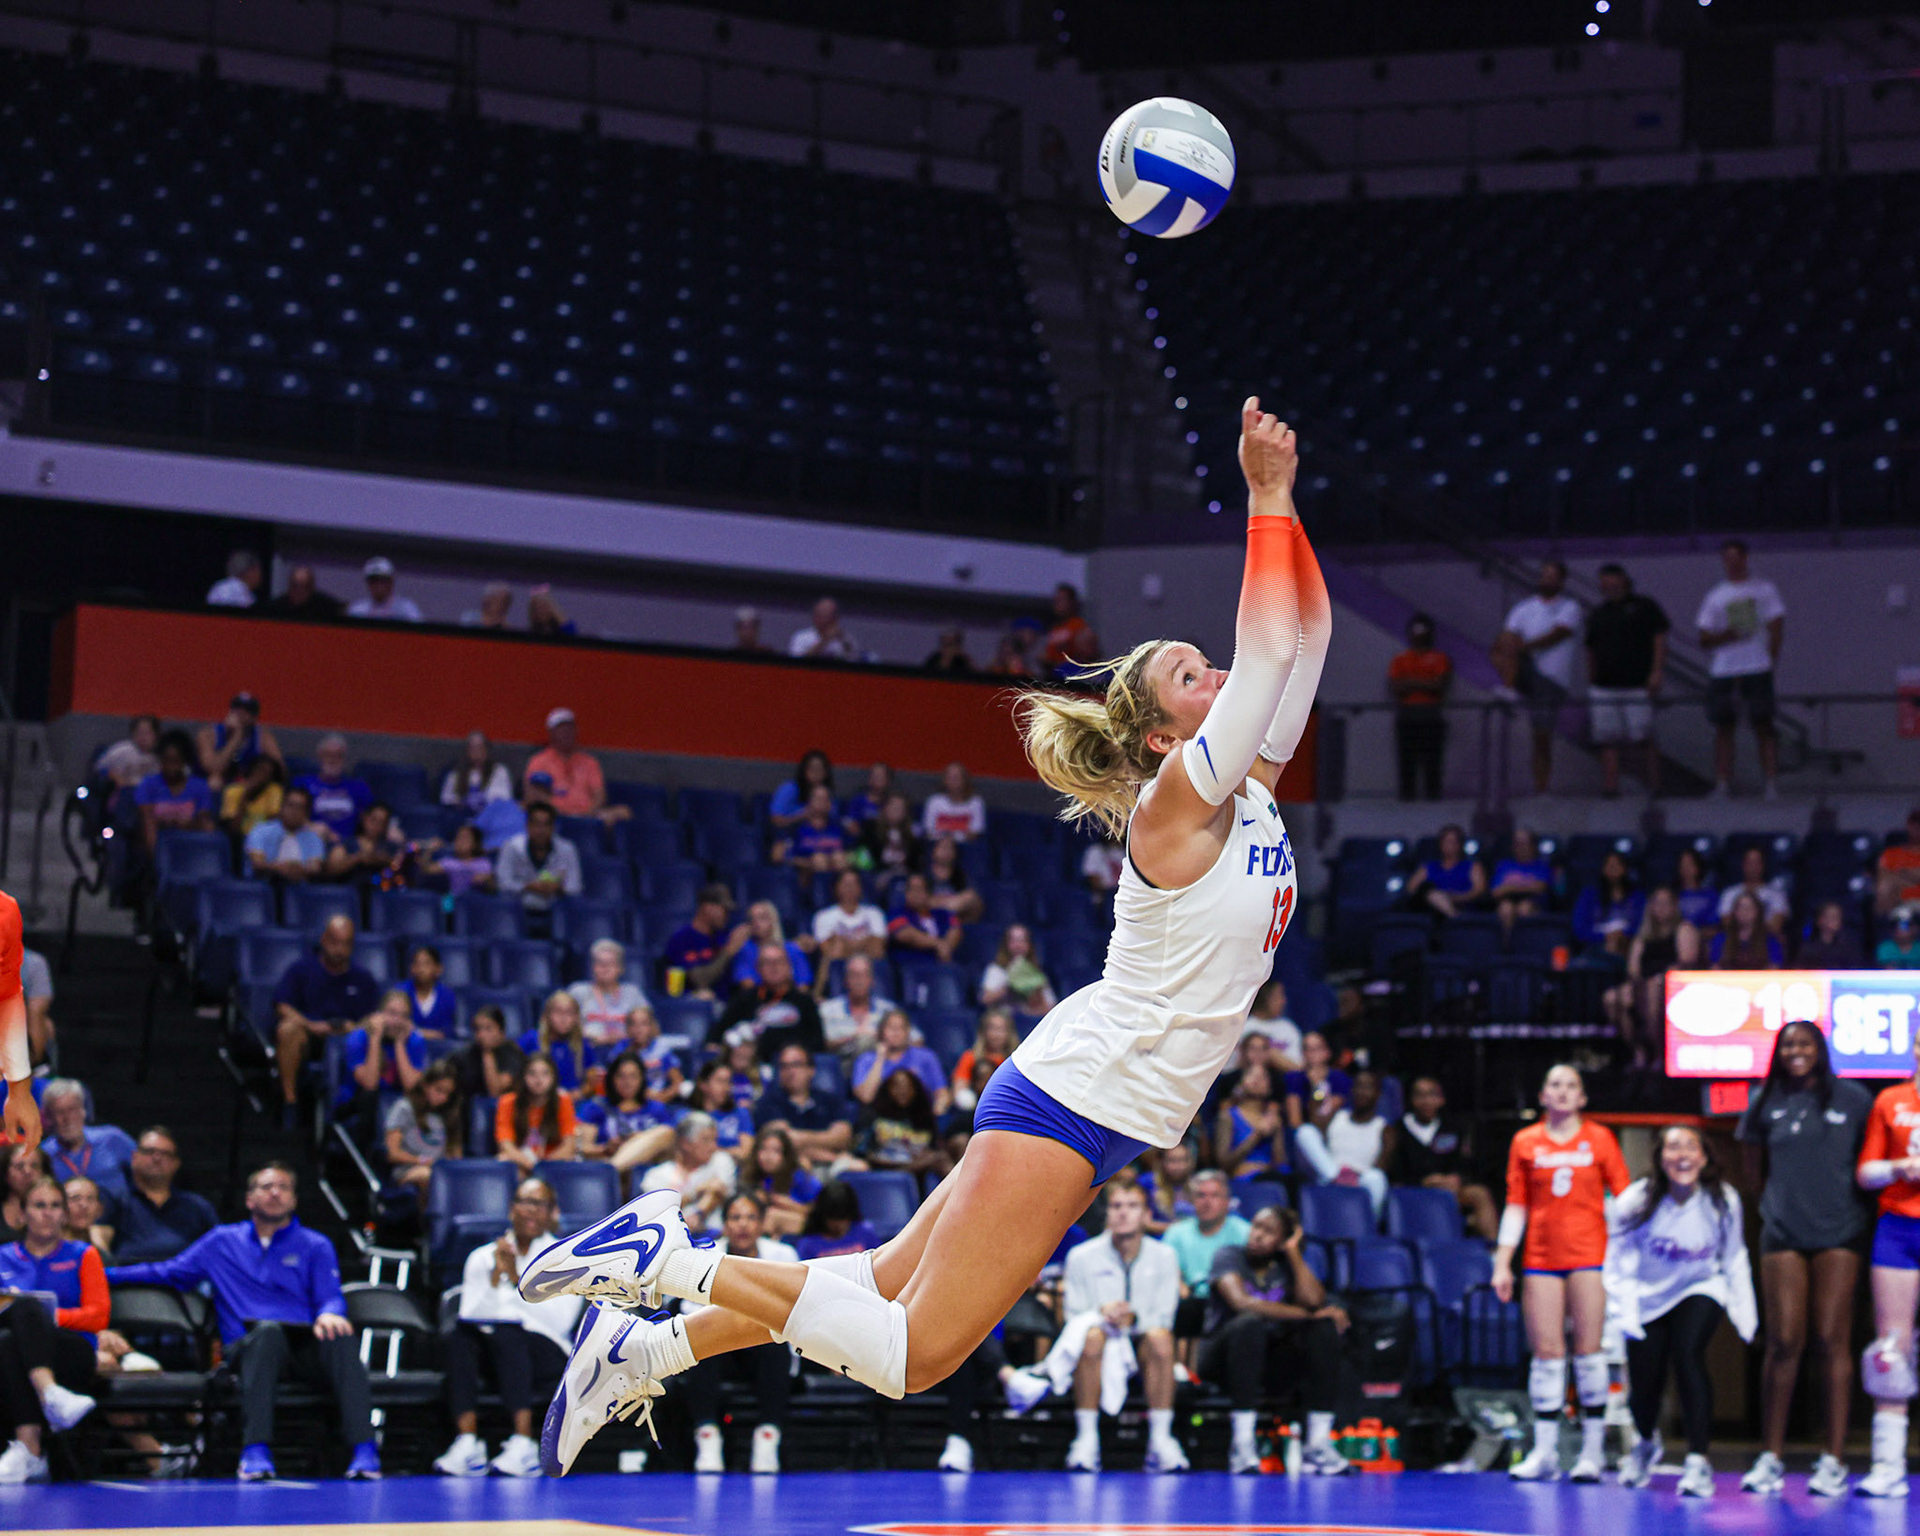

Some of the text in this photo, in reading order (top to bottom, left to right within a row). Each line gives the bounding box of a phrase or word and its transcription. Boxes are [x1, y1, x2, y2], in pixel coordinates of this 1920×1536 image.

[1263, 885, 1293, 953] 13
[1833, 994, 1915, 1056] SET
[1551, 1167, 1574, 1197] 6
[609, 1318, 631, 1346] FLORIDA
